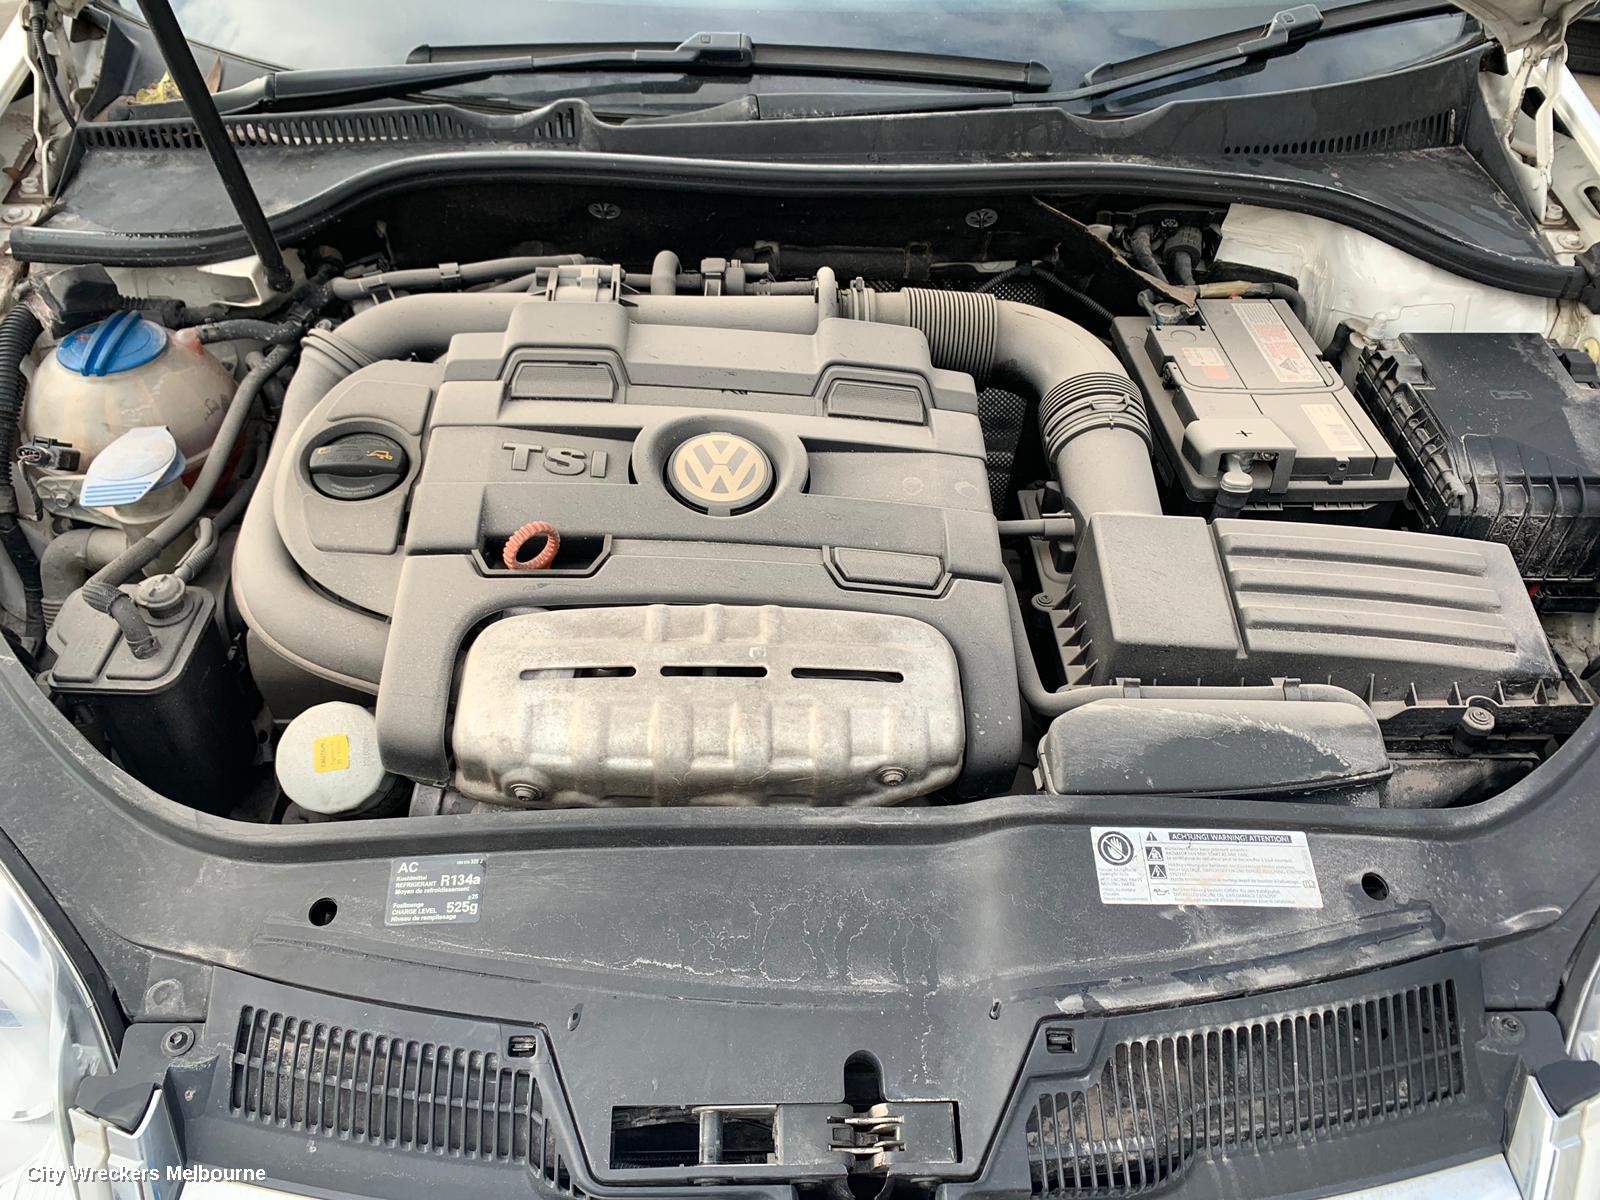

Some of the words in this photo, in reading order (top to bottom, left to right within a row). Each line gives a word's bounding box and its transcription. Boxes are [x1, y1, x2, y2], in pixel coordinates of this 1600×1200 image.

[502, 441, 608, 478] TSI
[1171, 833, 1209, 842] ACHTUNG!
[1210, 834, 1248, 842] WARNING!
[1248, 835, 1290, 843] ATTENTION!
[398, 862, 419, 873] AC
[441, 874, 481, 886] R134a
[446, 902, 478, 914] 525g
